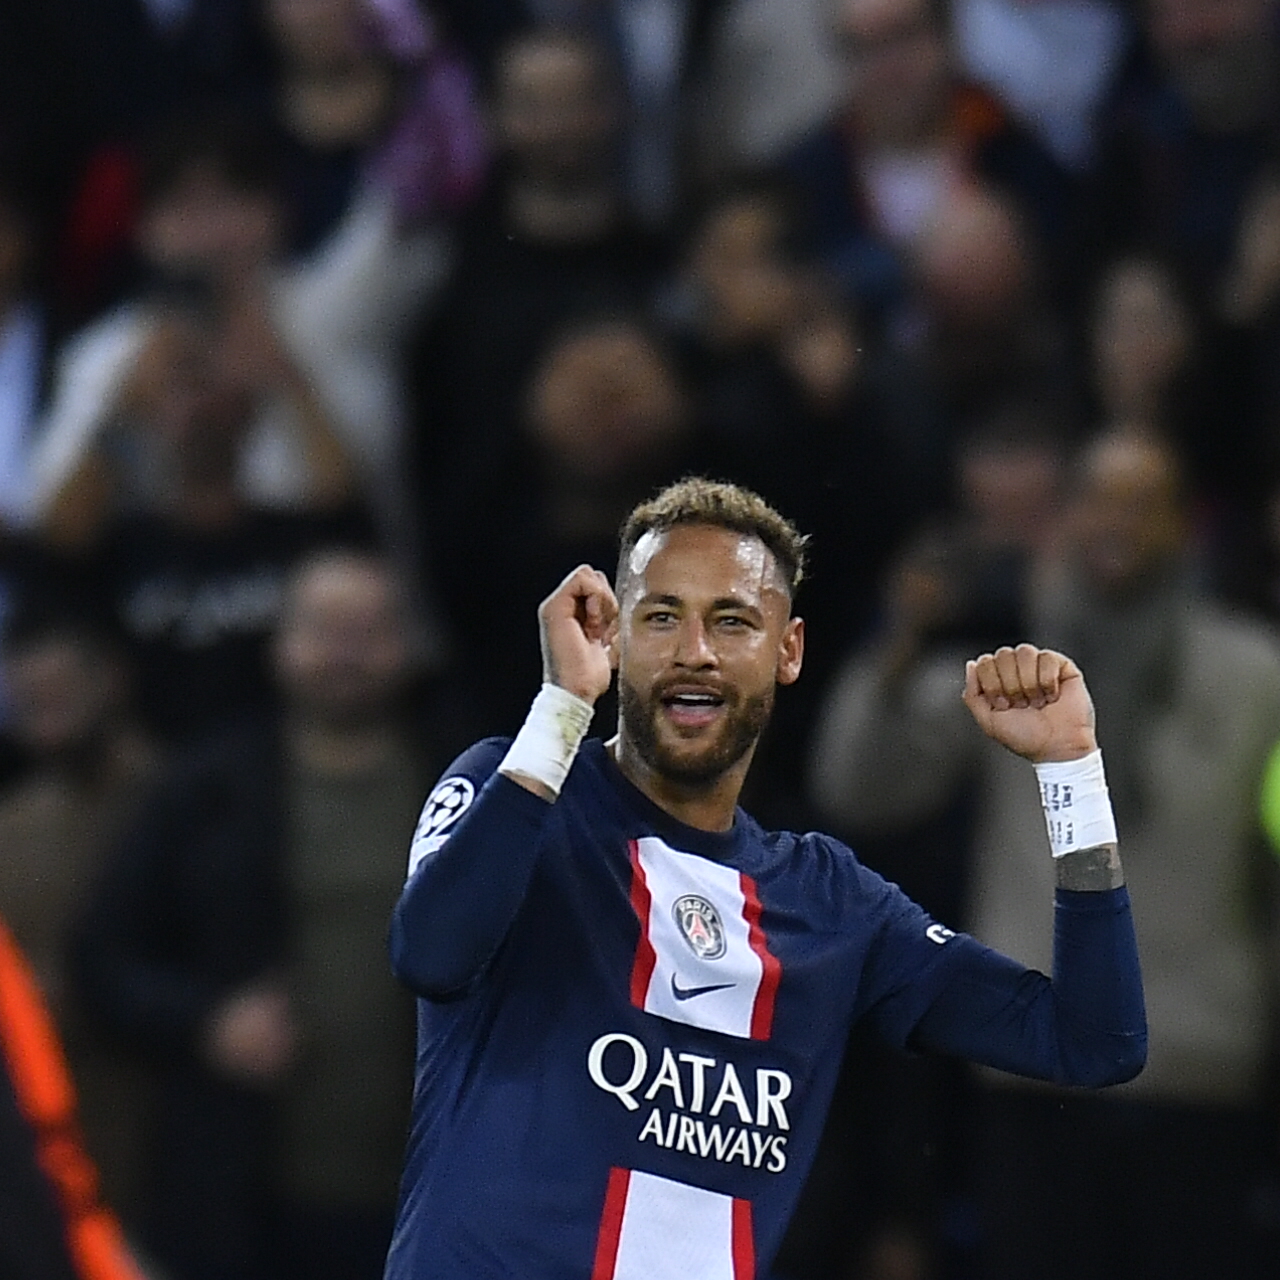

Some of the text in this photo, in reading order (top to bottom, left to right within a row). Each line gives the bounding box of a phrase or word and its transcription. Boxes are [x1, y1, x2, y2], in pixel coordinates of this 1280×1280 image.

[678, 900, 713, 921] PARIS
[588, 1033, 792, 1130] QATAR
[638, 1108, 787, 1173] AIRWAYS
